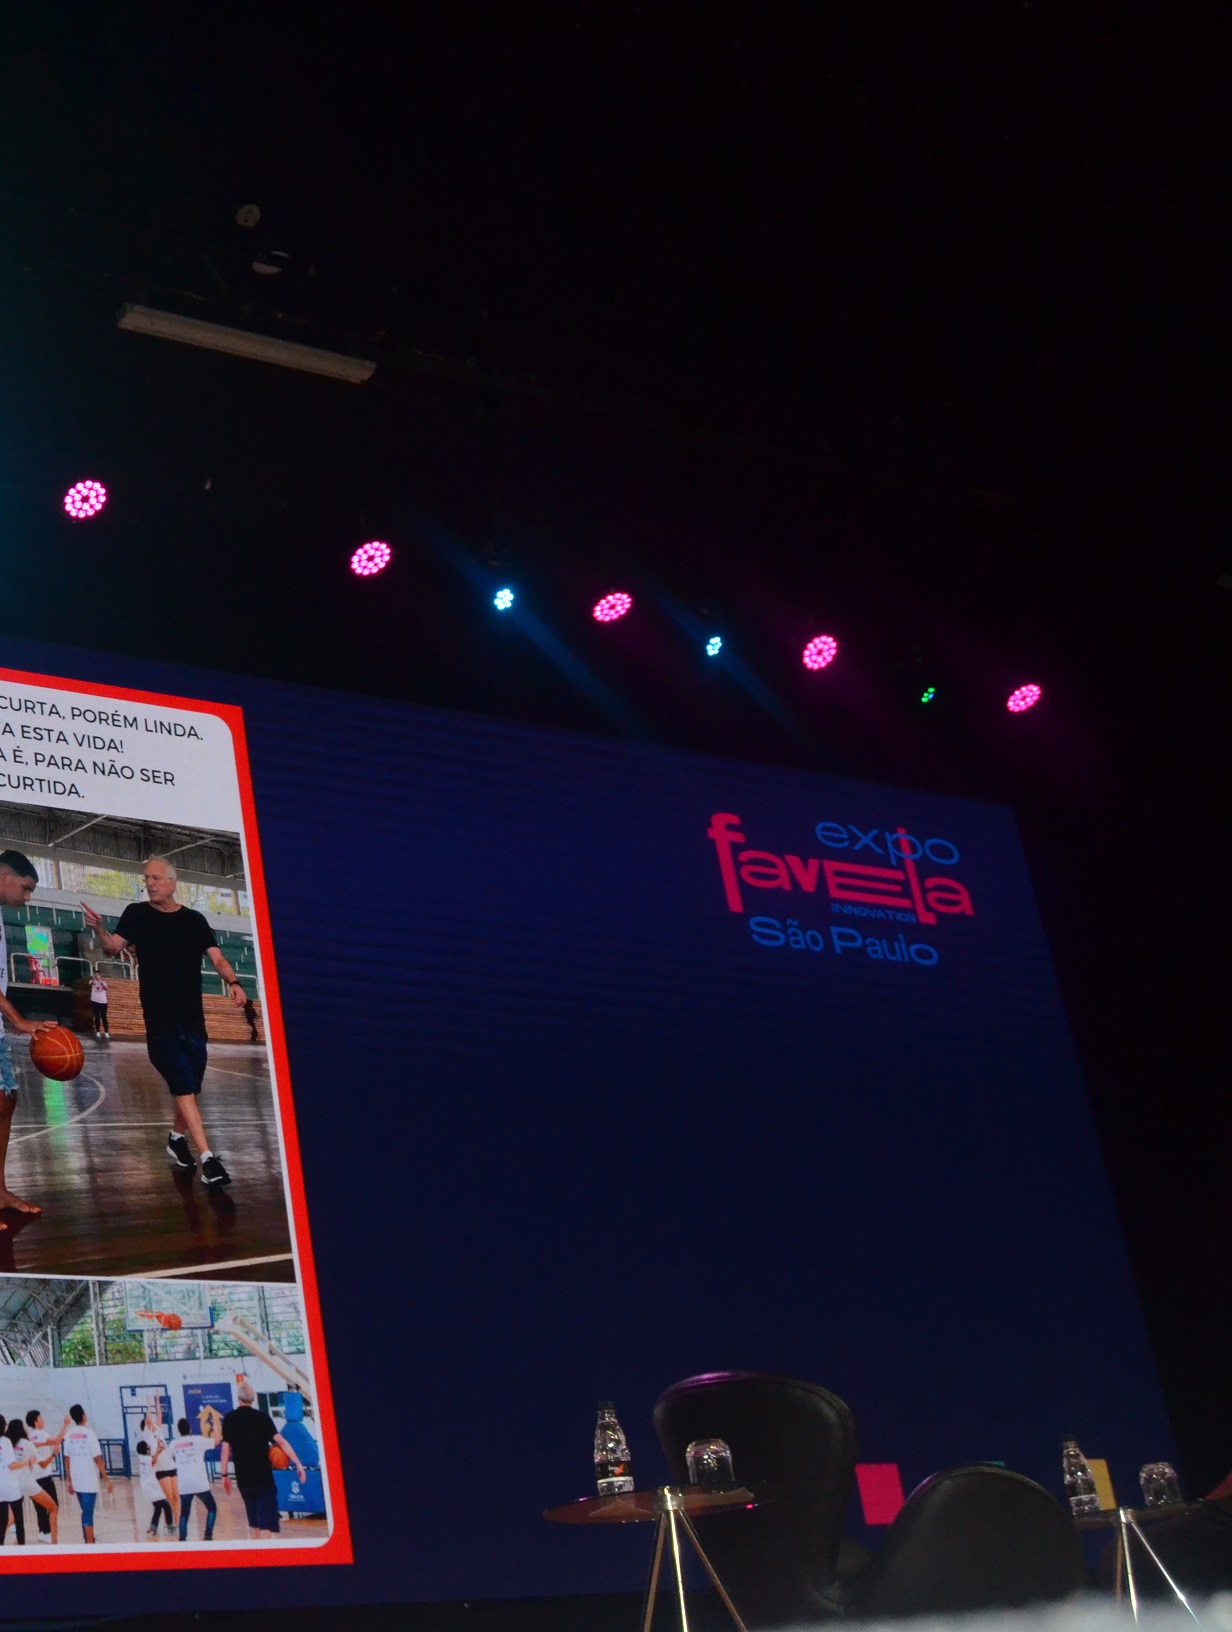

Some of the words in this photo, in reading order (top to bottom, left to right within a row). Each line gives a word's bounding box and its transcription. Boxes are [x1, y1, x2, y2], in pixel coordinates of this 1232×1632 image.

[20, 724, 70, 747] ESTA
[72, 732, 125, 754] VIDA!
[70, 706, 139, 732] PORÉM
[144, 718, 204, 743] LINDA.
[12, 748, 29, 767] É,
[33, 751, 88, 775] PARA
[92, 758, 135, 781] NÃO
[139, 766, 176, 787] SER
[815, 821, 961, 866] expo
[830, 902, 917, 924] INNOVATION
[748, 916, 824, 952] São
[829, 926, 939, 966] Paulo
